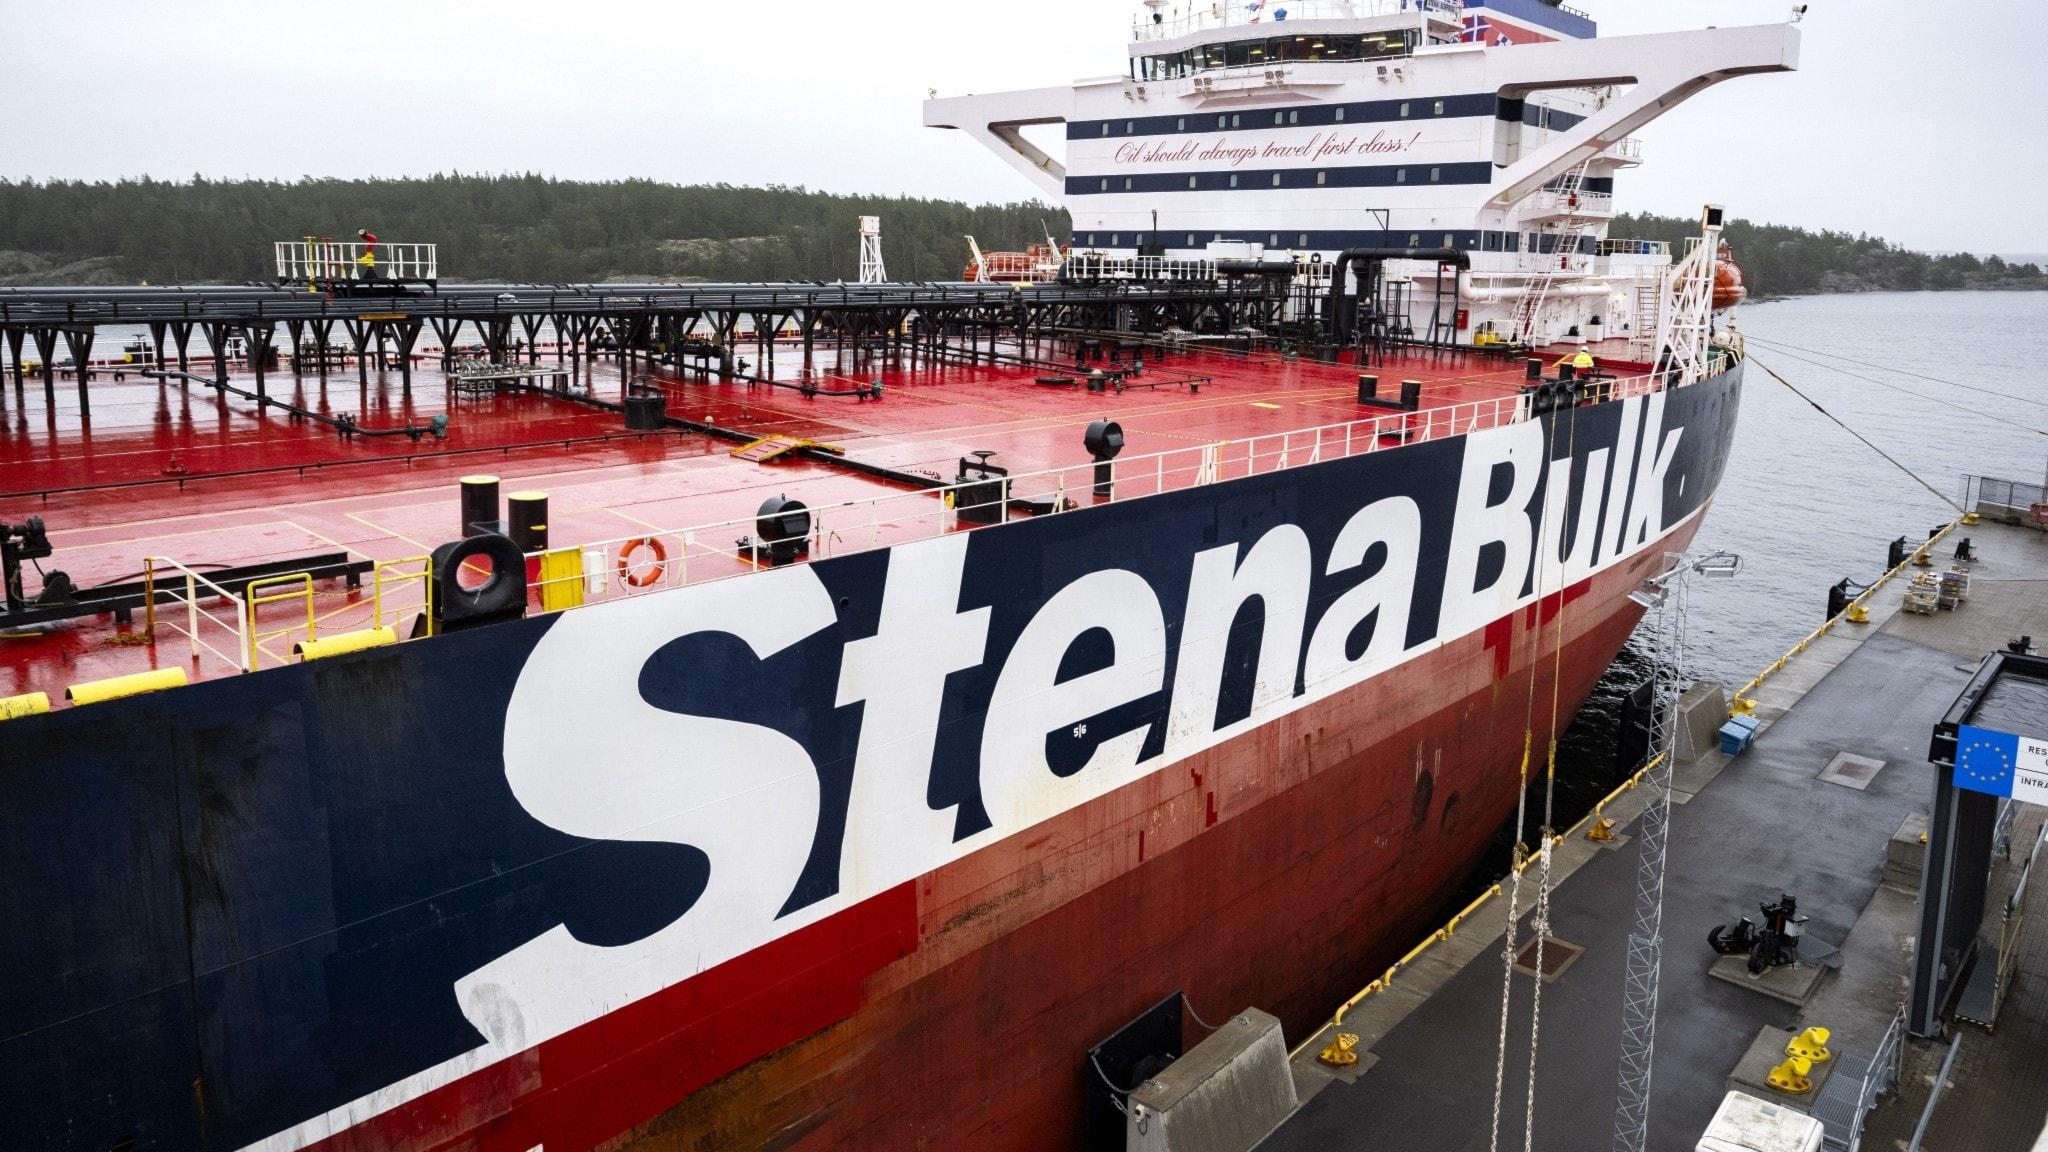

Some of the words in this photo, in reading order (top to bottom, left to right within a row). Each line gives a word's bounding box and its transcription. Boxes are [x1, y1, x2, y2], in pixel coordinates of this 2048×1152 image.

[1114, 141, 1148, 164] Oil
[1143, 137, 1200, 162] should
[1199, 137, 1258, 167] always
[1262, 132, 1321, 158] travel
[1311, 131, 1357, 162] first
[1358, 129, 1422, 154] class!
[454, 496, 1422, 1050] Stena
[1436, 392, 1685, 640] Bulk
